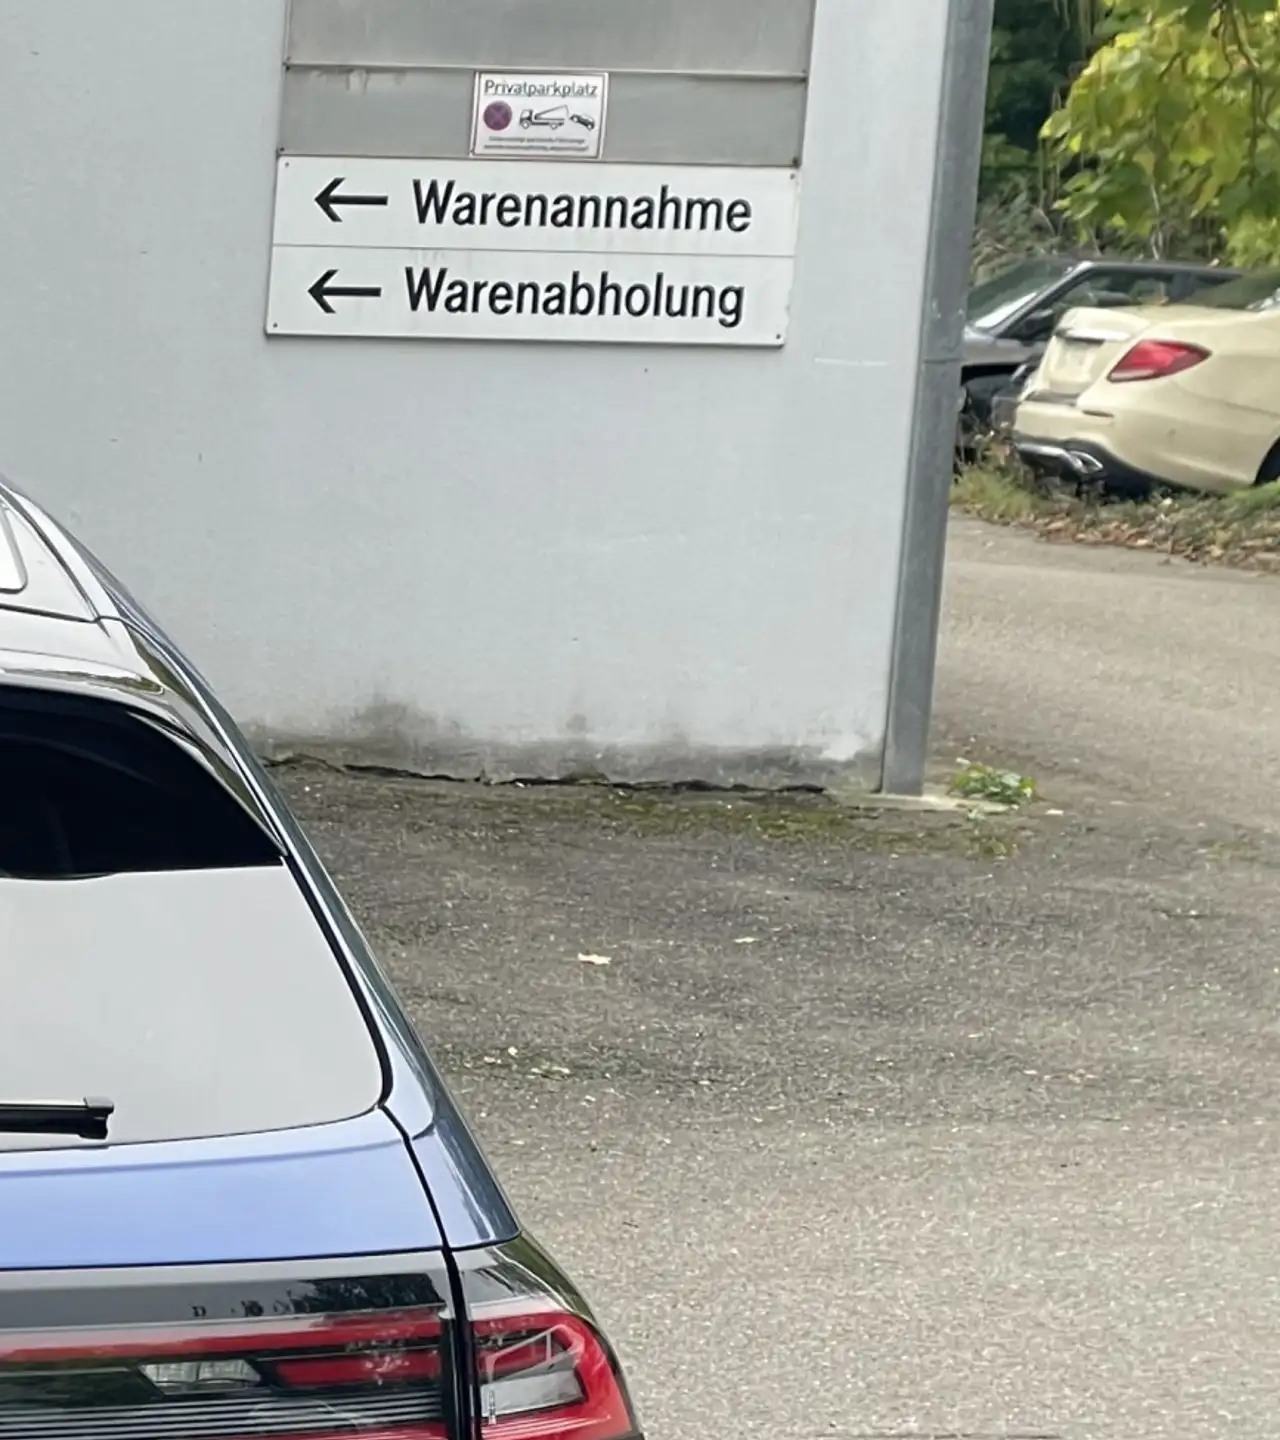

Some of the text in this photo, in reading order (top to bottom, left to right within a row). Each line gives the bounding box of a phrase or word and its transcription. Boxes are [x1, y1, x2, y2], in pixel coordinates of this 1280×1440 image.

[484, 79, 598, 98] Privatparkplatz
[412, 179, 752, 232] Warenannahme
[405, 267, 745, 328] Warenabholung
